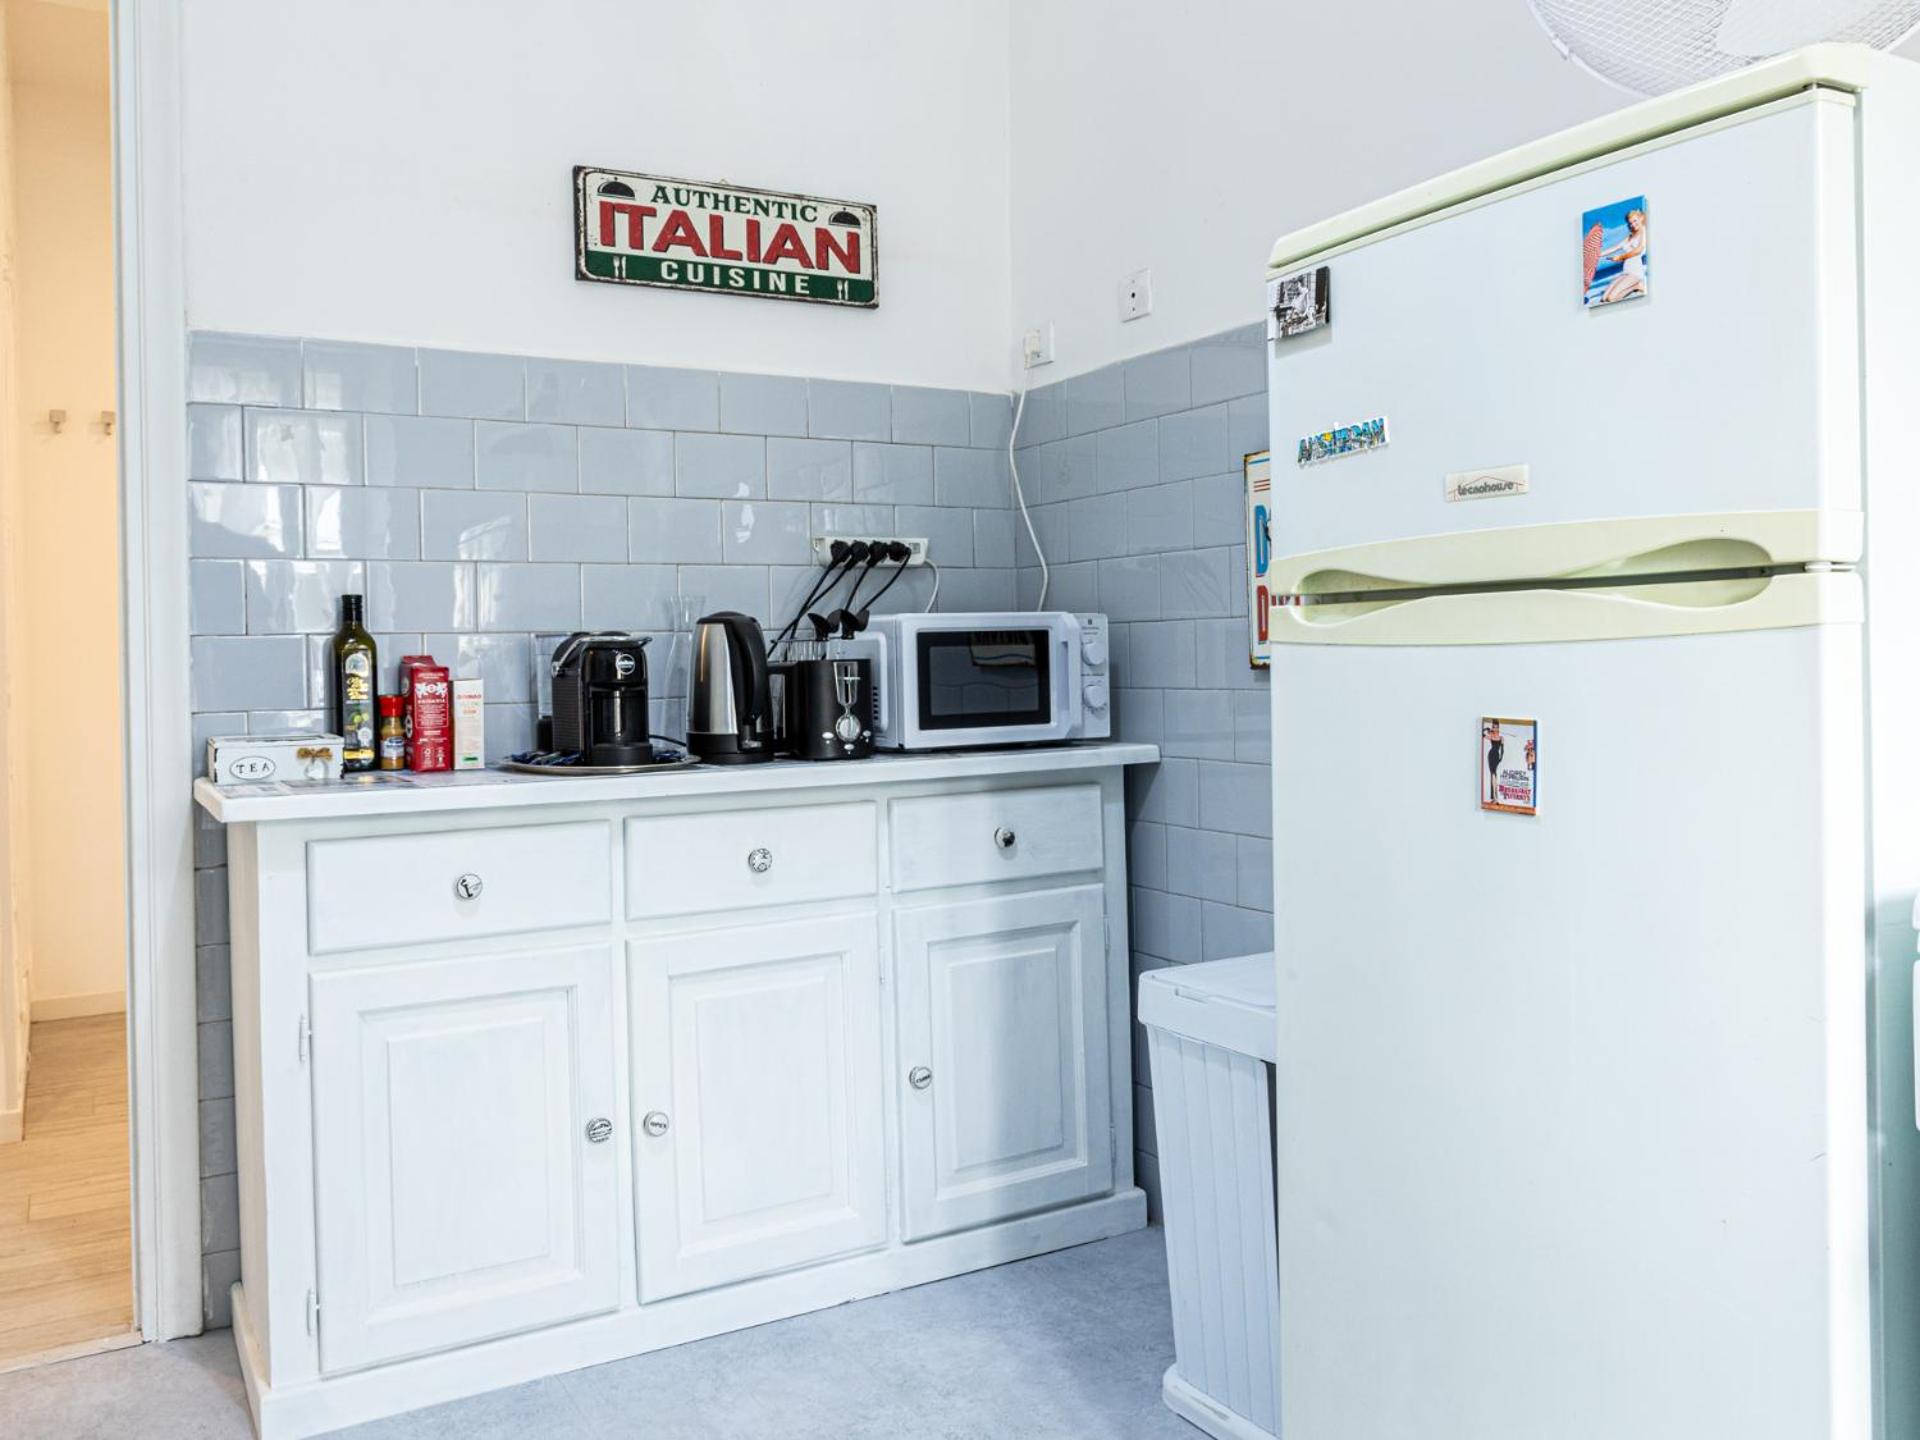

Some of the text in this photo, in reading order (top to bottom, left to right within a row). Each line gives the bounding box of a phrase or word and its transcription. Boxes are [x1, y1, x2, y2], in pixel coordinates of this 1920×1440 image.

[651, 185, 818, 223] AUTHENTIC
[600, 200, 862, 275] ITALIAN
[660, 260, 810, 294] CUISINE
[1457, 481, 1514, 496] tecnohouse
[235, 762, 271, 774] TEA
